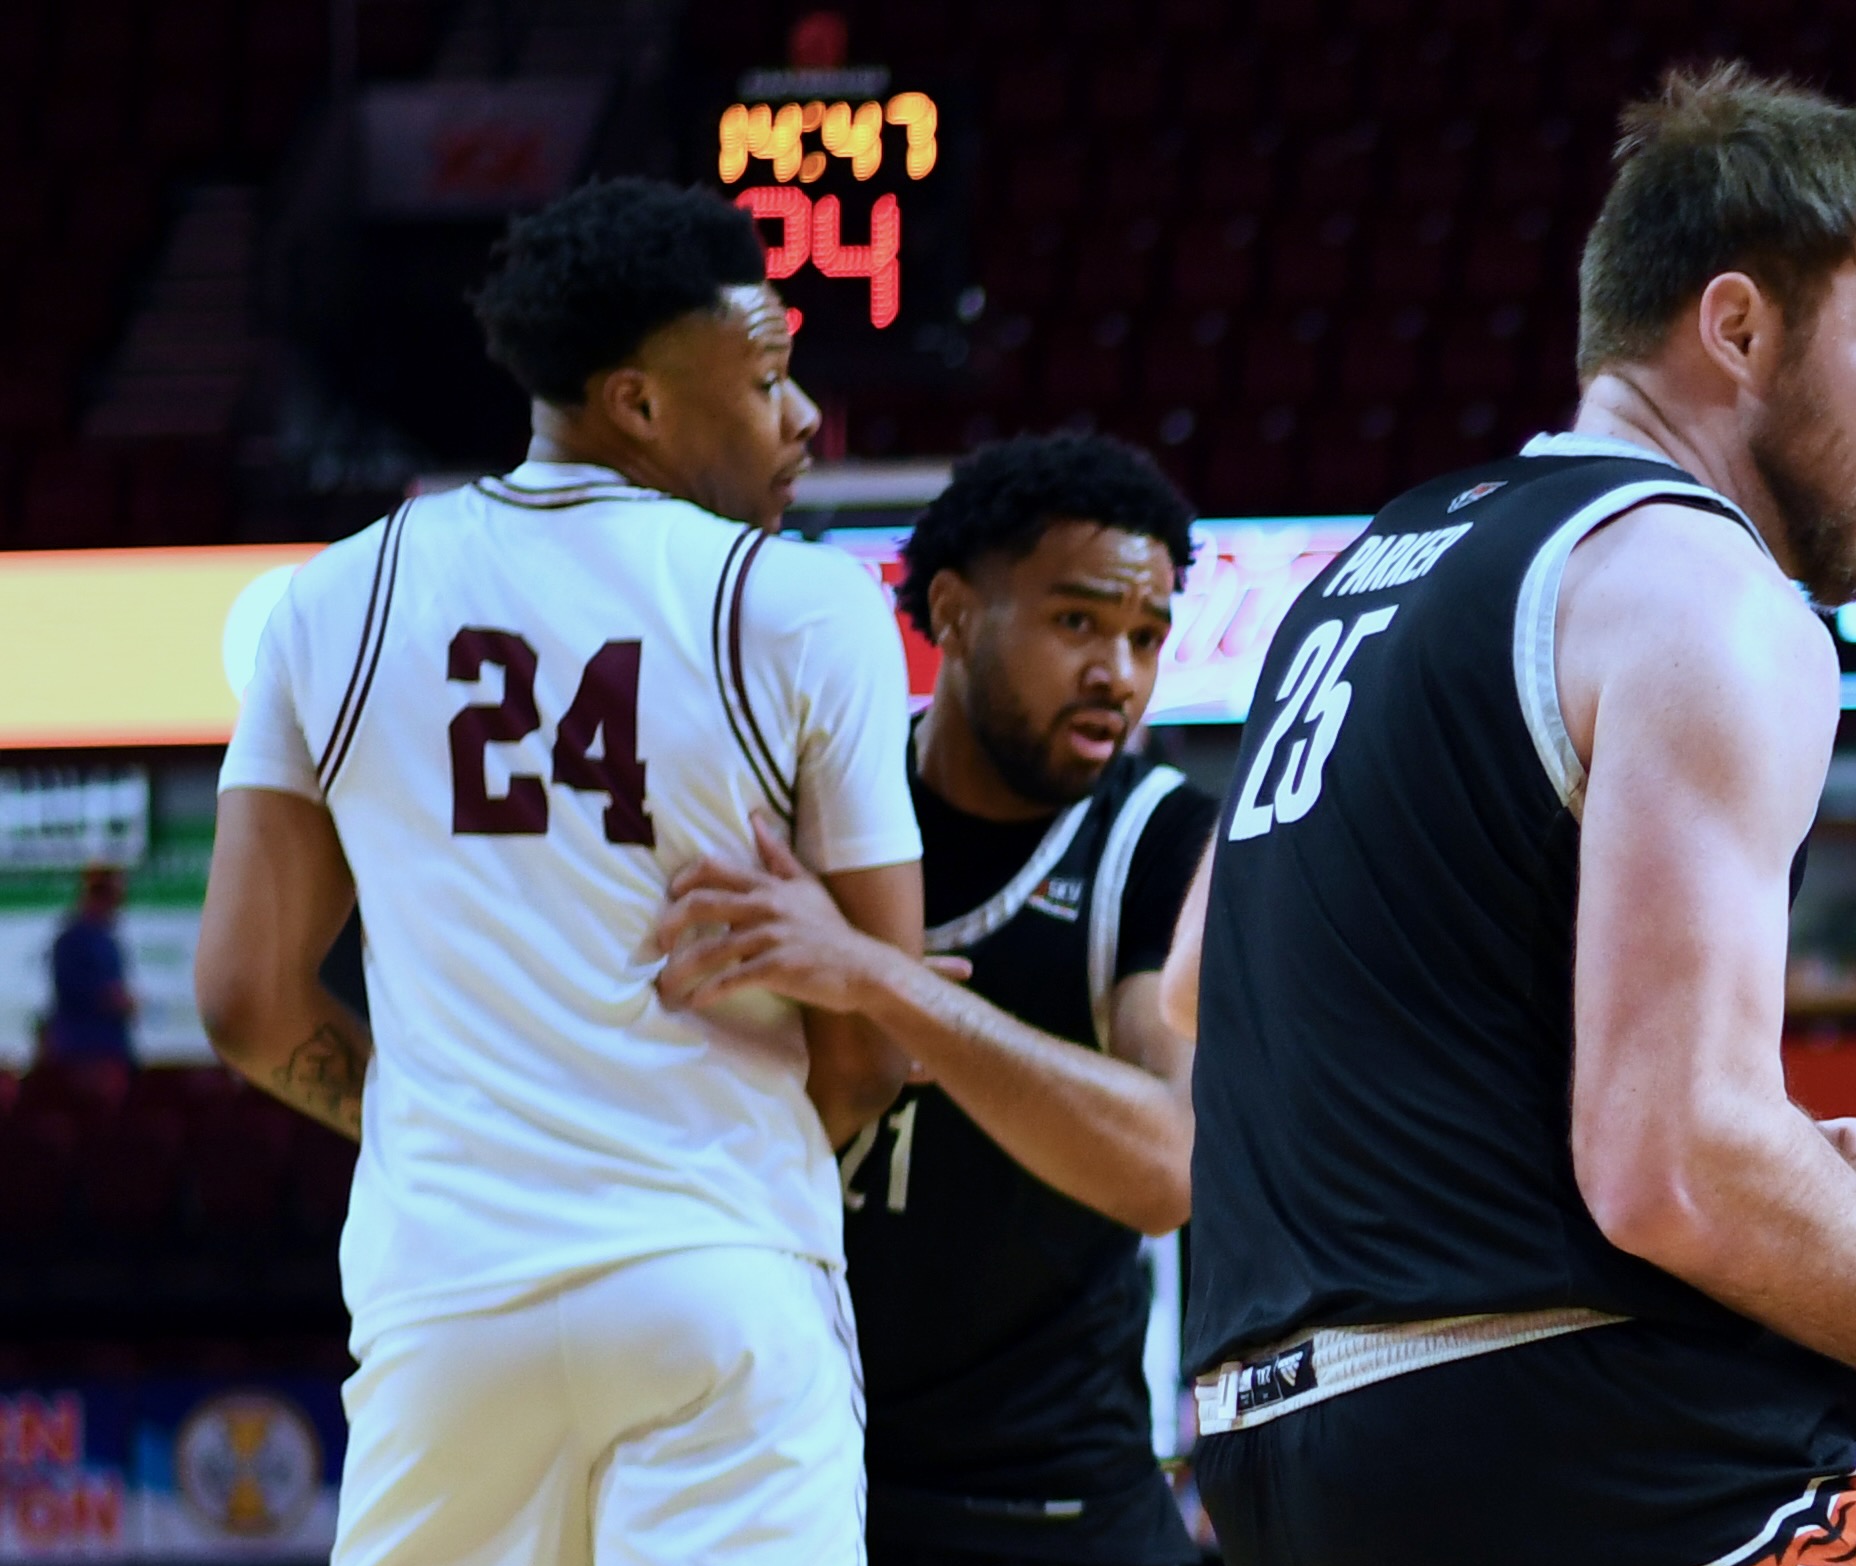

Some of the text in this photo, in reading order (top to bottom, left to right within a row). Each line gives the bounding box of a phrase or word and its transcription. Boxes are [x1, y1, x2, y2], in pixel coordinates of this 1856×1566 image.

[718, 91, 937, 184] 14:47
[1322, 521, 1473, 598] PARKER
[447, 626, 656, 848] 24
[1228, 603, 1399, 842] 25
